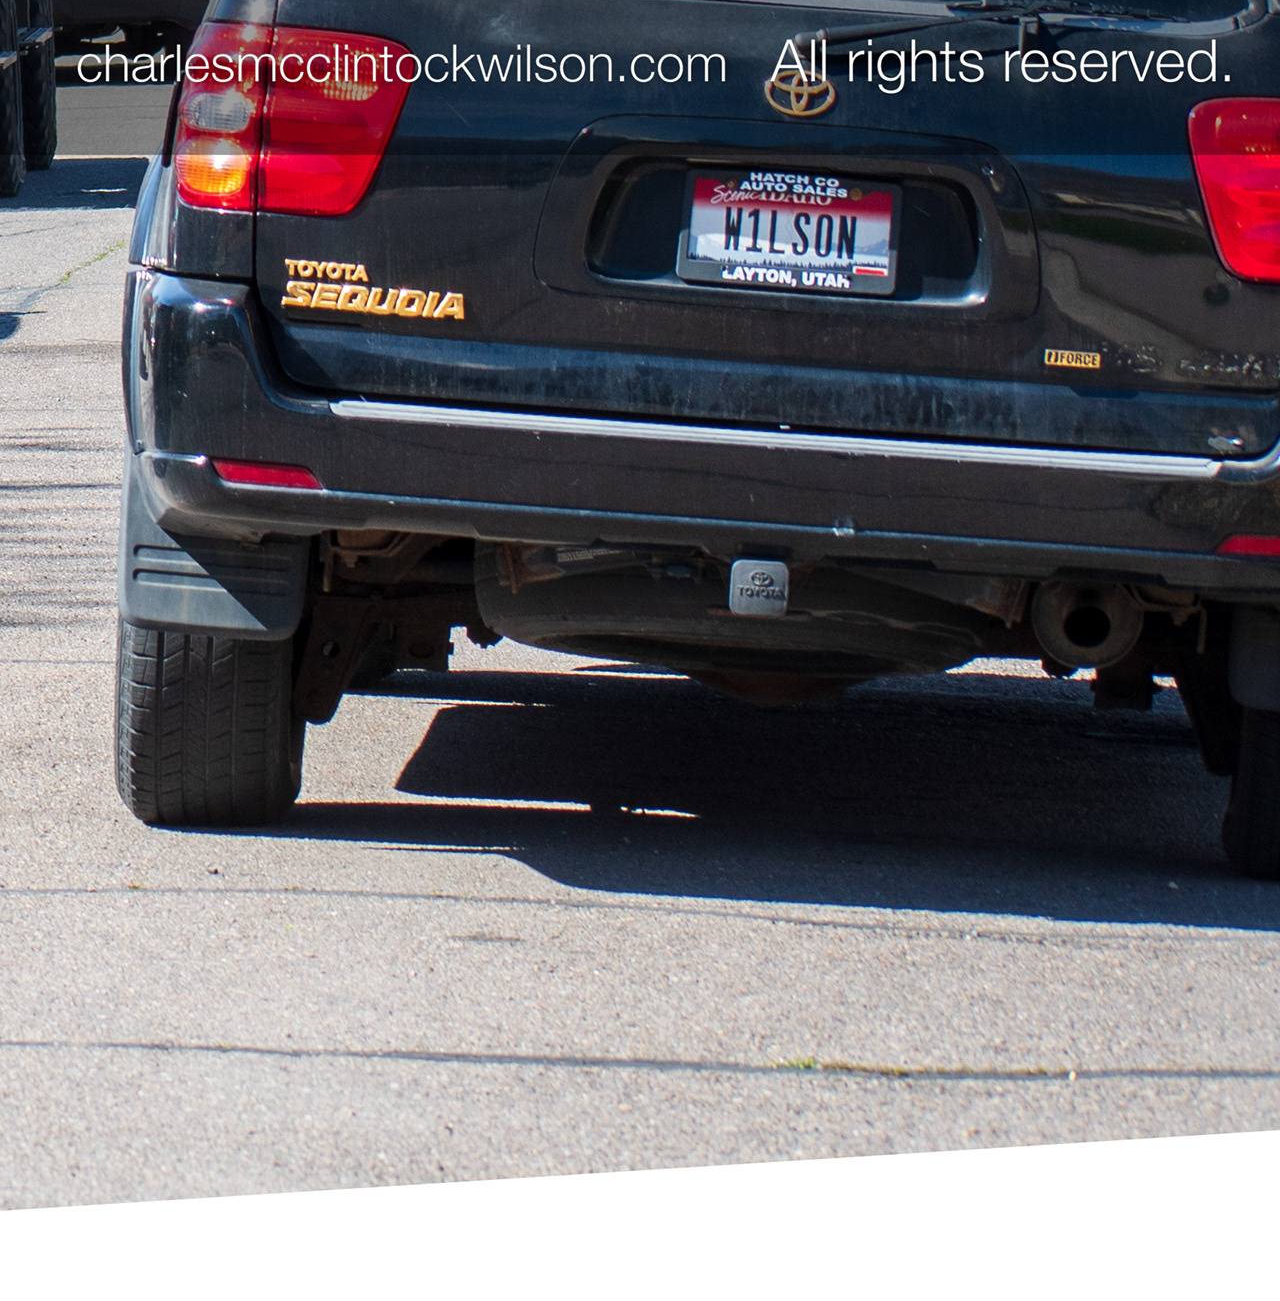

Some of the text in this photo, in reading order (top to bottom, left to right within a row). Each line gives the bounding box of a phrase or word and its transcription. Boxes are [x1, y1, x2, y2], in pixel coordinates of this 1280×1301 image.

[739, 181, 848, 198] AUTO SALES
[750, 171, 840, 188] HATCH CO
[710, 184, 761, 205] Scenic
[284, 258, 369, 282] TOYOTA
[721, 265, 851, 289] LAYTON, UTAH
[281, 280, 465, 320] SEQUOIA
[737, 585, 787, 601] TOYOTA
